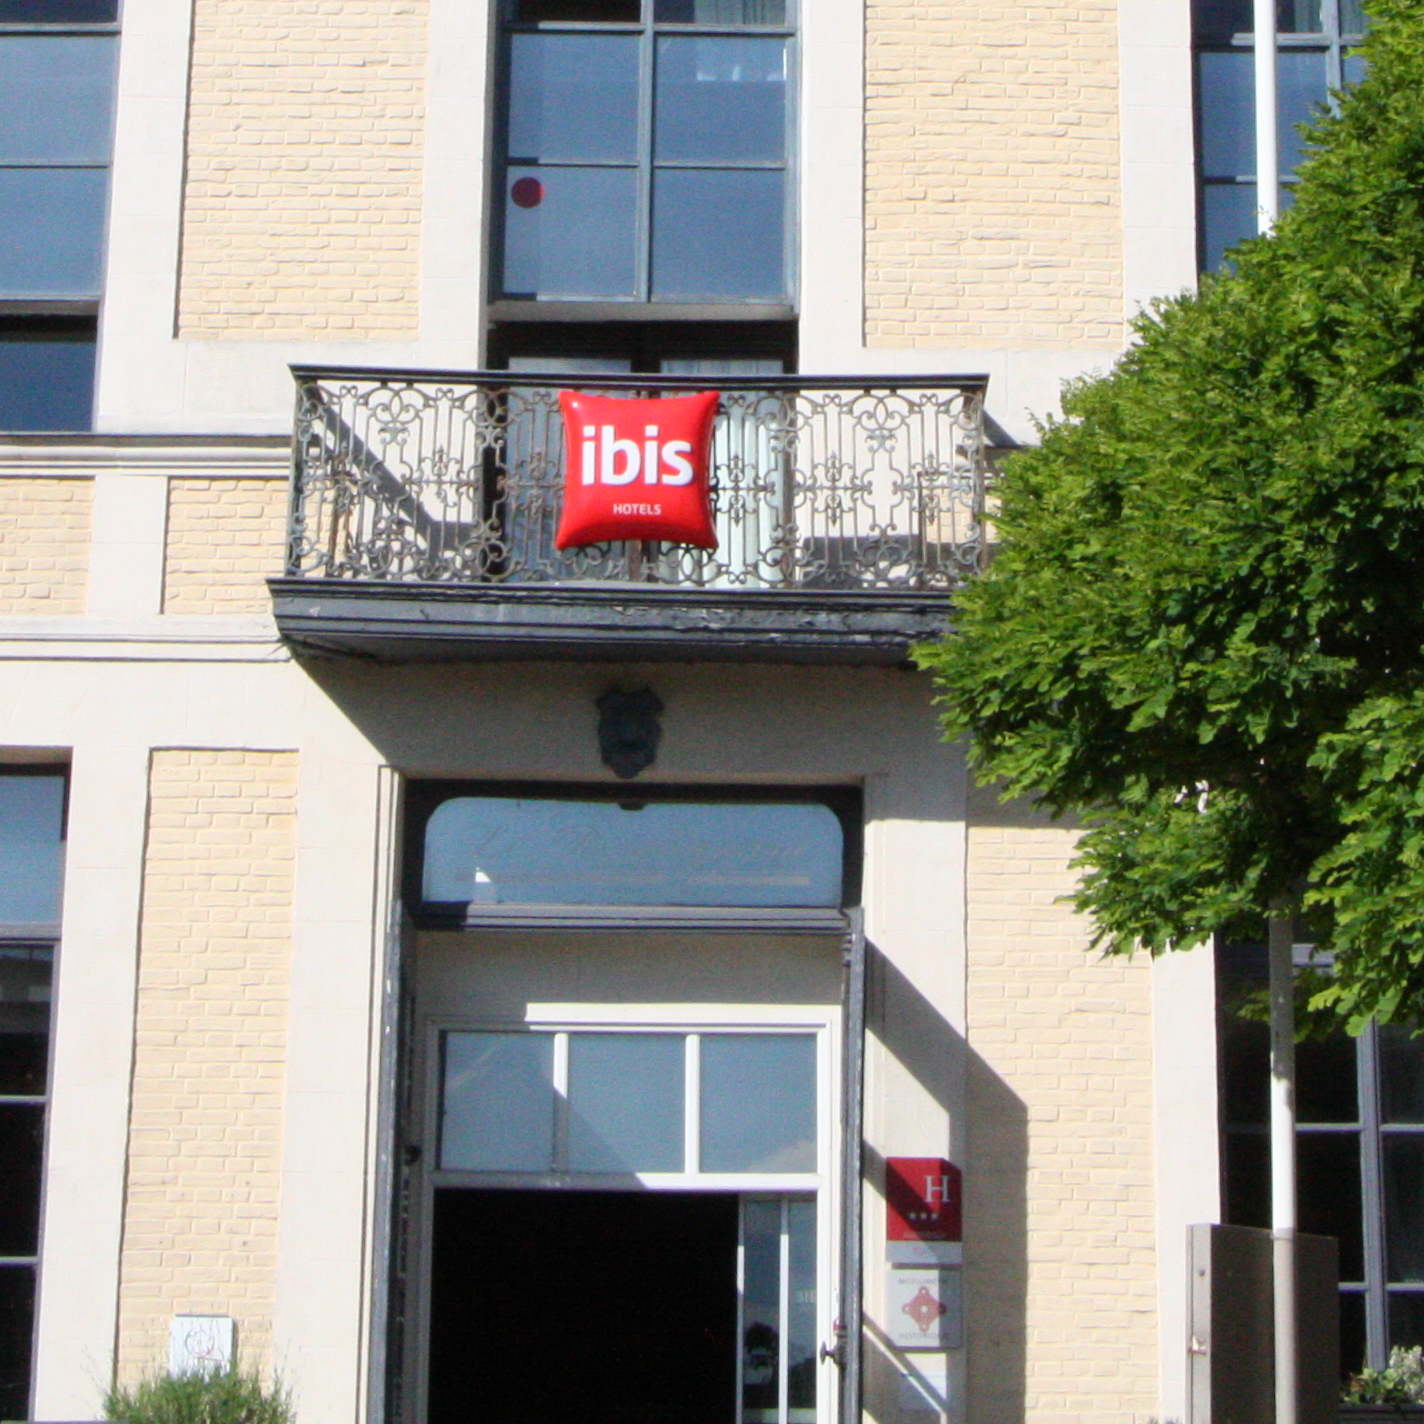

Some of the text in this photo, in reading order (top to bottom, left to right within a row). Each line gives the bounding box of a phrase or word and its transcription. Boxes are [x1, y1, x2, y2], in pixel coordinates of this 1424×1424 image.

[582, 425, 694, 486] ibis
[612, 504, 662, 515] HOTELS
[925, 1175, 950, 1203] H
